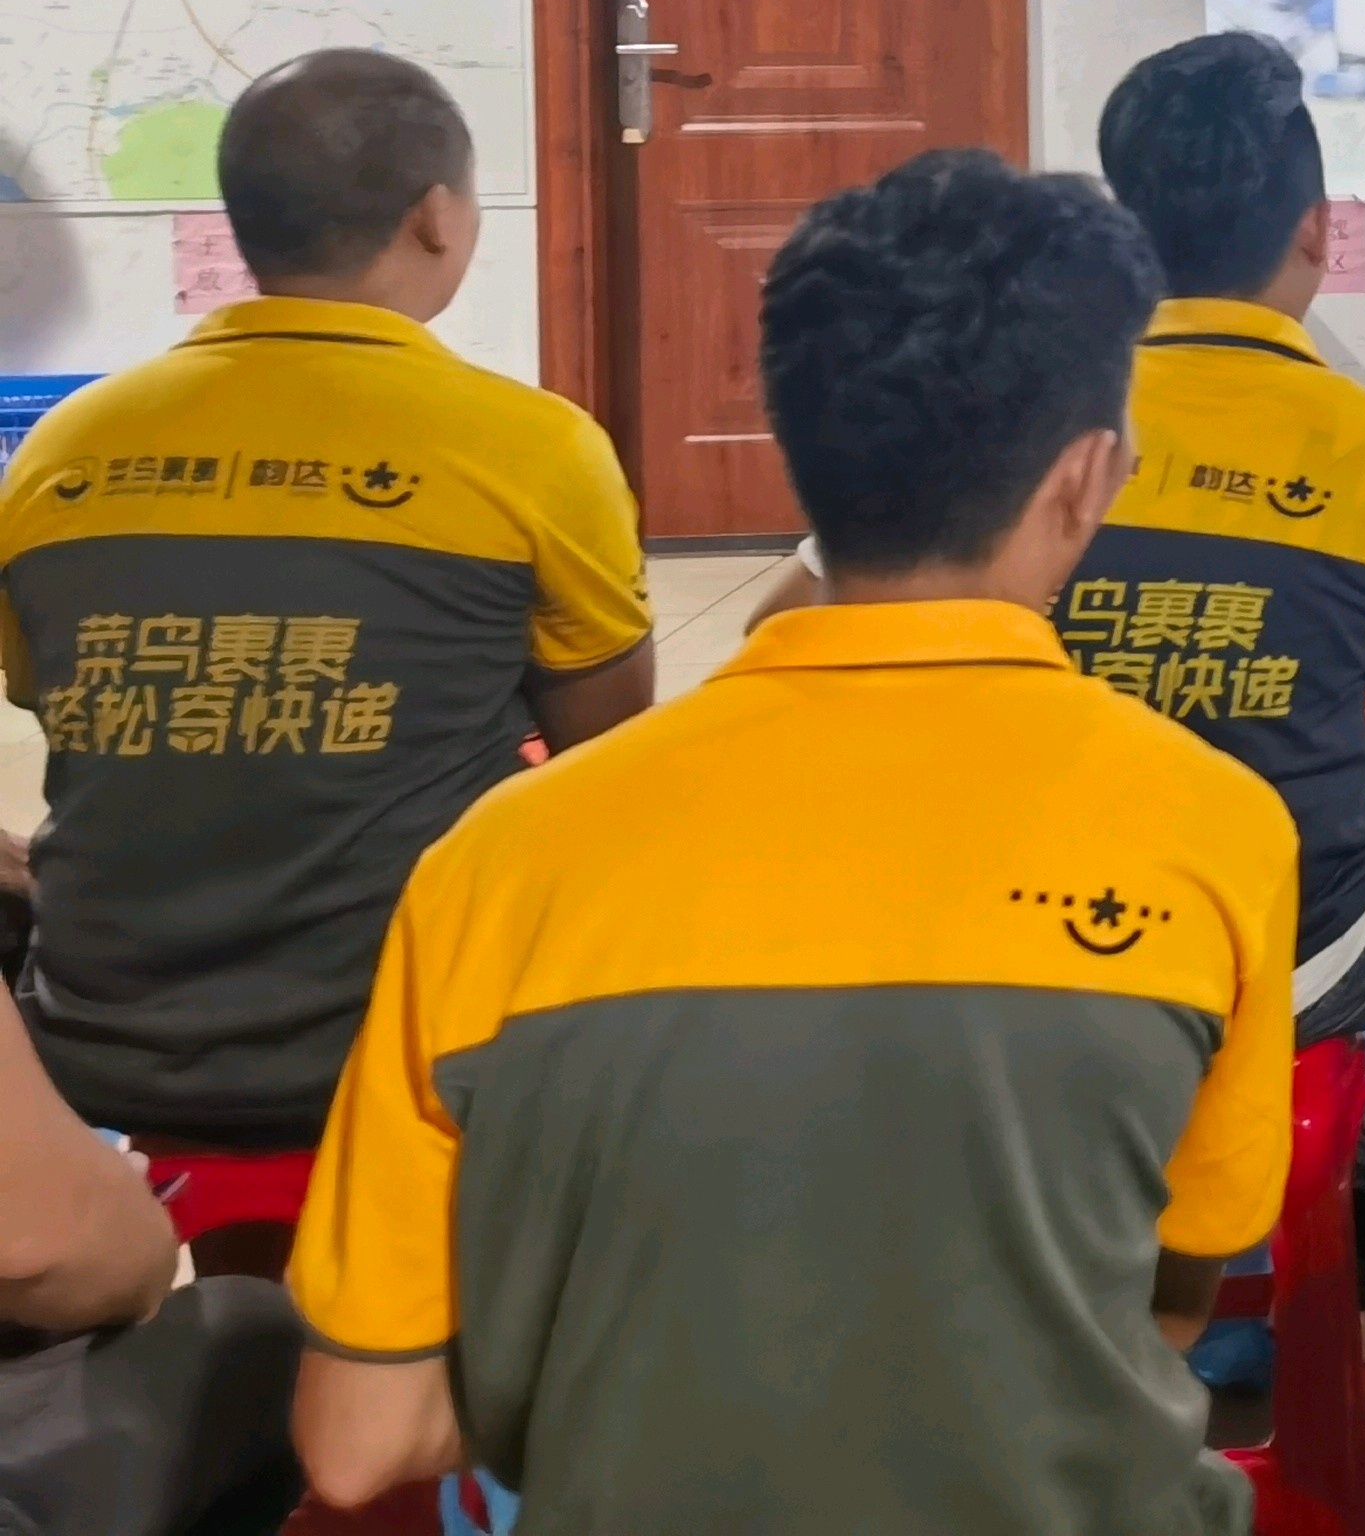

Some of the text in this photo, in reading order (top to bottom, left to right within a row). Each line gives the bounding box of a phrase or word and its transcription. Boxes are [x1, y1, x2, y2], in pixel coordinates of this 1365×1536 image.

[76, 613, 362, 686] 菜鸟裹裹
[1050, 576, 1275, 652] 鸟裹裹
[42, 681, 402, 756] 轻松寄快递
